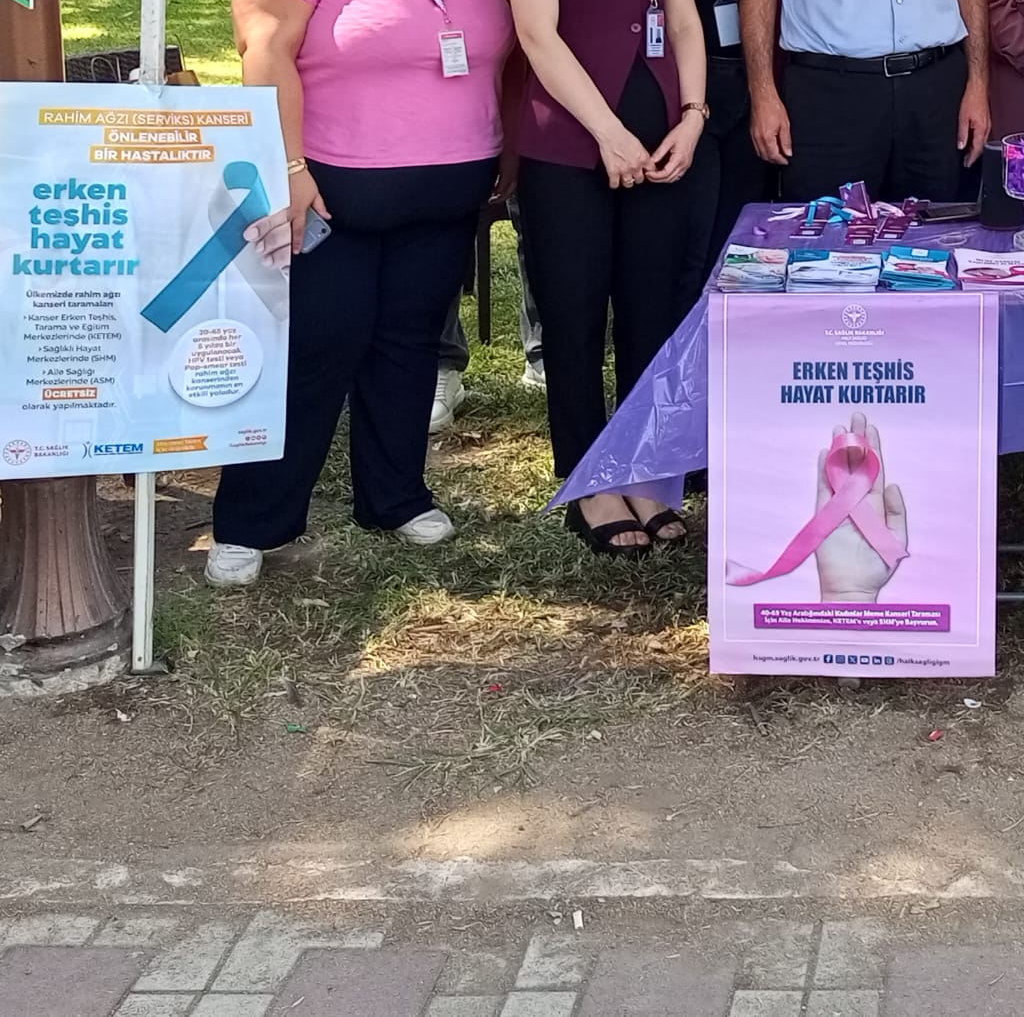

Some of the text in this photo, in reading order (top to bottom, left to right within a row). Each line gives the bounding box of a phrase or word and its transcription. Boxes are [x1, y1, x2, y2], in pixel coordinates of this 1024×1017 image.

[44, 110, 249, 126] RAHİM AĞZI (SERVİKS) KANSERİ
[109, 128, 199, 143] ÖNLENEBİLİR
[94, 147, 211, 161] BİR HASTALIKTIR
[33, 178, 126, 200] erken
[29, 202, 128, 227] teşhis
[30, 227, 124, 254] hayat
[12, 254, 140, 275] kurtarır
[26, 289, 73, 298] Ülkemizde
[75, 290, 101, 298] rahim
[33, 300, 66, 308] kanseri
[61, 313, 86, 321] Erken
[88, 332, 122, 340] (KETEM)
[76, 345, 101, 353] Hayat
[91, 354, 117, 363] (SHM)
[793, 359, 914, 384] ERKEN TEŞHİS
[26, 377, 115, 386] Merkezlerinde (ASM)
[44, 388, 96, 399] ÜCRETSİZ
[781, 385, 926, 403] HAYAT KURTARIR
[22, 402, 50, 411] olarak
[94, 443, 144, 453] KETEM
